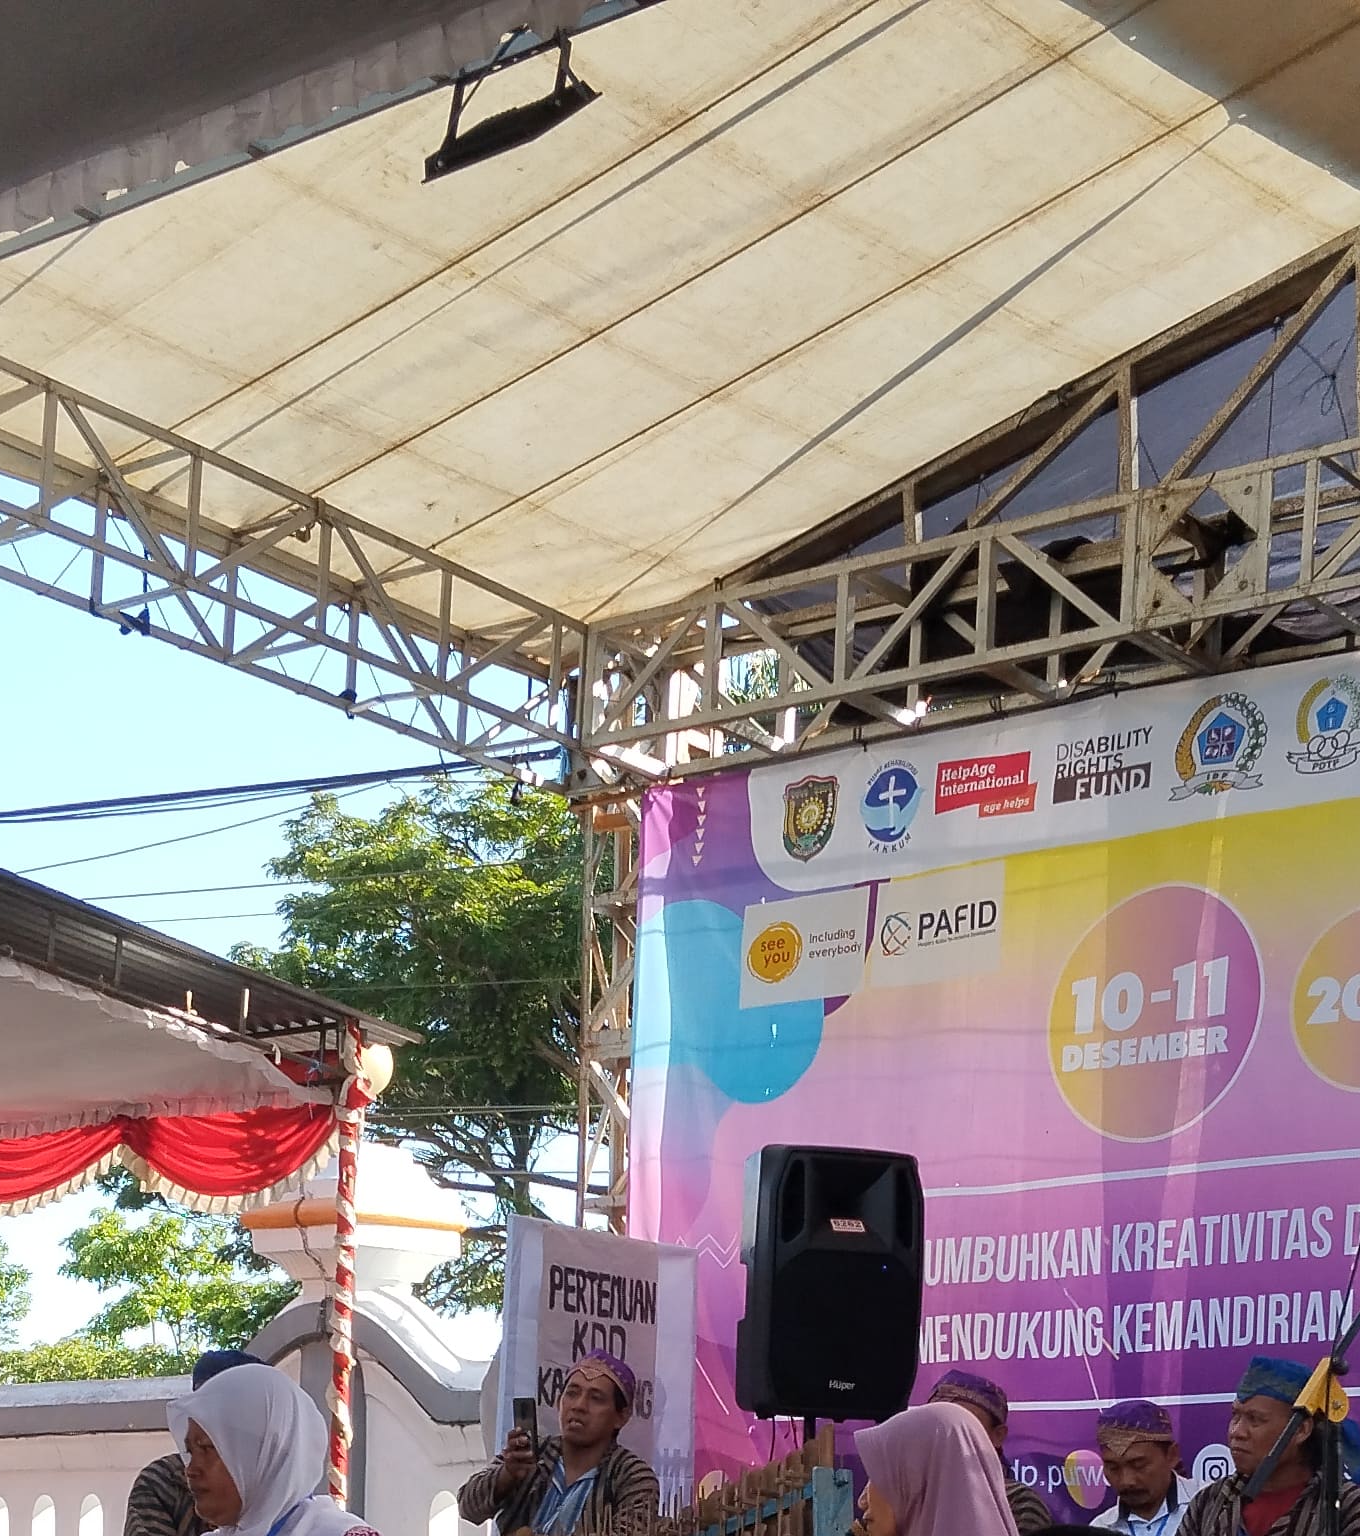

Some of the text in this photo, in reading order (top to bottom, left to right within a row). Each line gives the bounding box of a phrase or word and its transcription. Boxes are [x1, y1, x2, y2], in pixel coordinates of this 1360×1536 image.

[1056, 726, 1154, 762] DISABILITY
[941, 762, 996, 783] HelpAge
[1056, 752, 1123, 780] RIGHTS
[940, 769, 1025, 798] International
[1075, 768, 1146, 800] FUND
[983, 796, 1030, 814] age helps
[867, 832, 912, 854] YAKKUM
[918, 900, 997, 940] PAFID
[760, 938, 786, 952] see
[808, 942, 862, 958] everybody
[809, 929, 856, 943] Including
[764, 952, 791, 968] you
[1061, 1025, 1230, 1073] DESEMBER
[924, 1226, 1103, 1287] UMBUHKAN
[1111, 1206, 1334, 1274] KREATIVITAS
[548, 1264, 657, 1325] PERTEMUAN
[1113, 1289, 1354, 1354] KEMANDIRIAN
